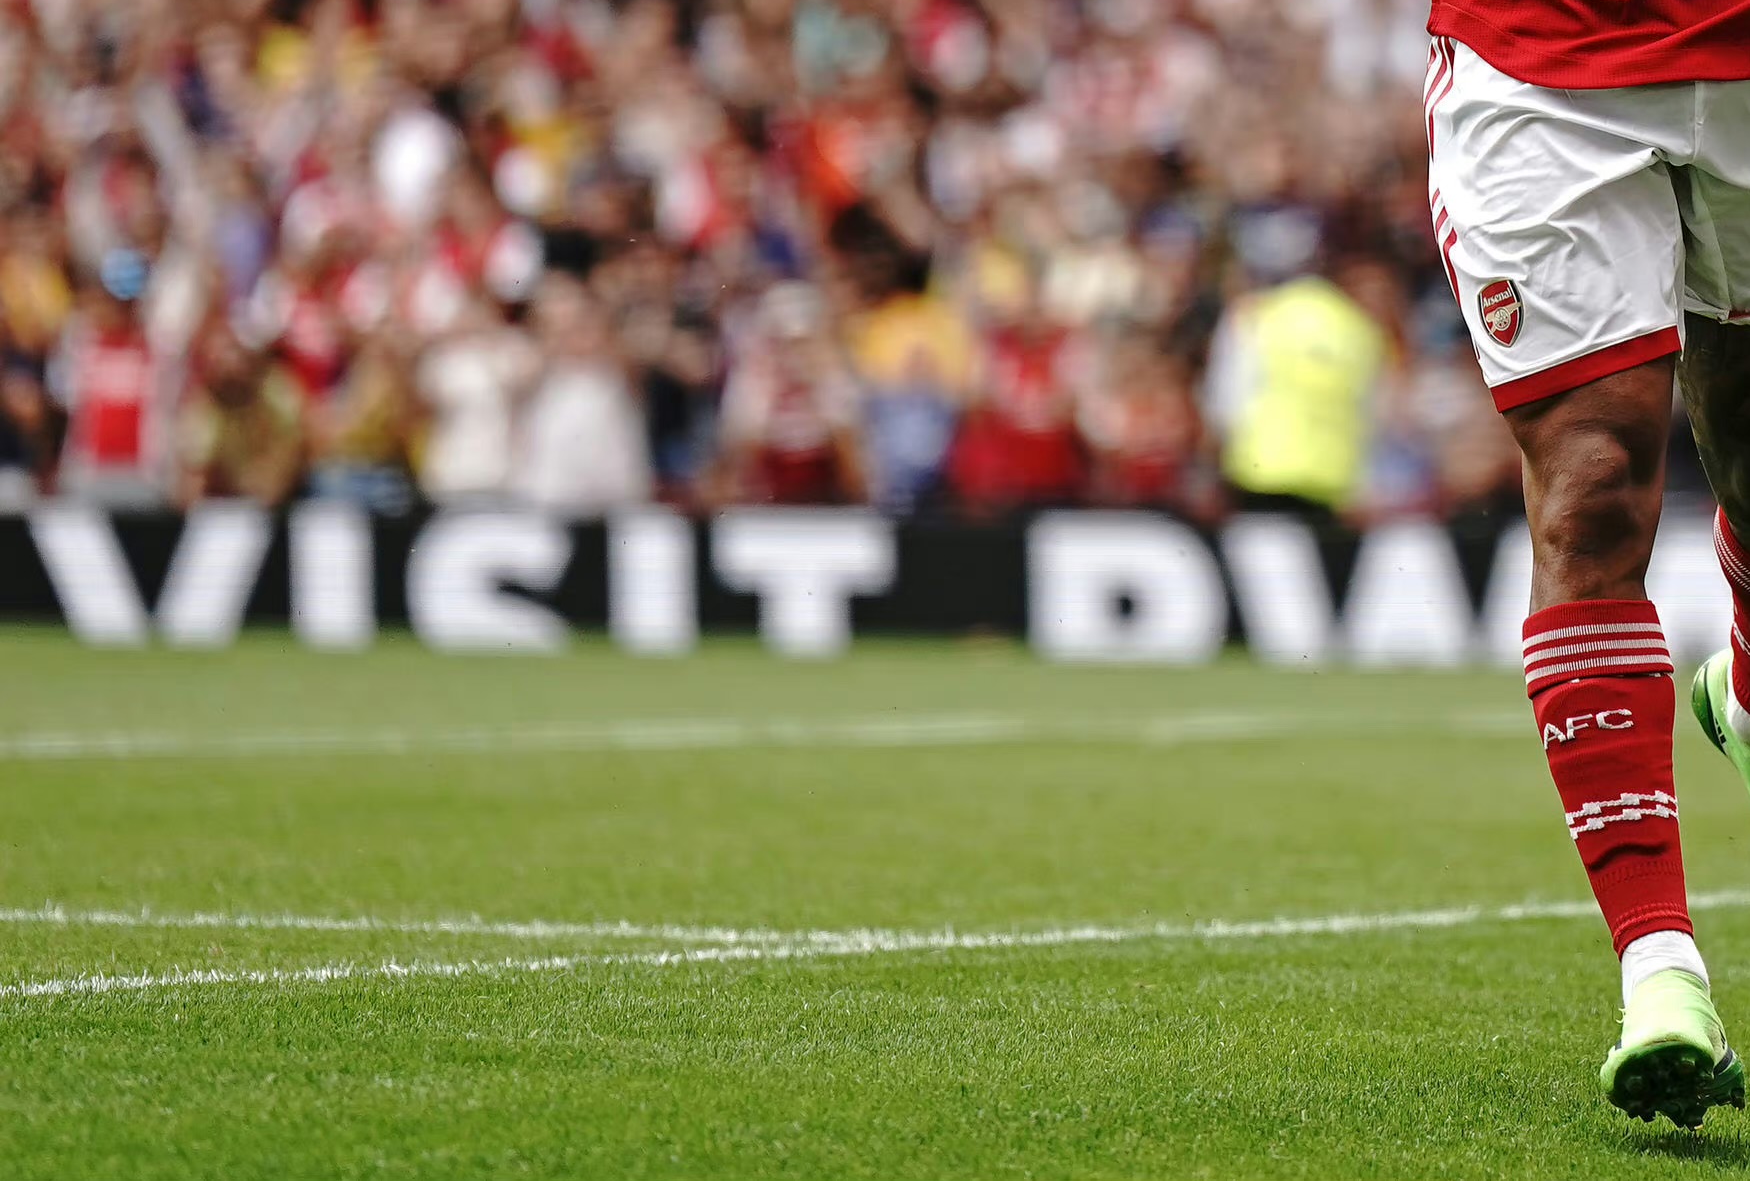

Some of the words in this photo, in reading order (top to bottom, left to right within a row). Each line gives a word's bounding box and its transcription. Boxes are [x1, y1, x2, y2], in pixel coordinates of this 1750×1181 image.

[1483, 287, 1513, 308] Arsenal
[28, 499, 900, 661] VISIT
[1543, 708, 1634, 751] AFC
